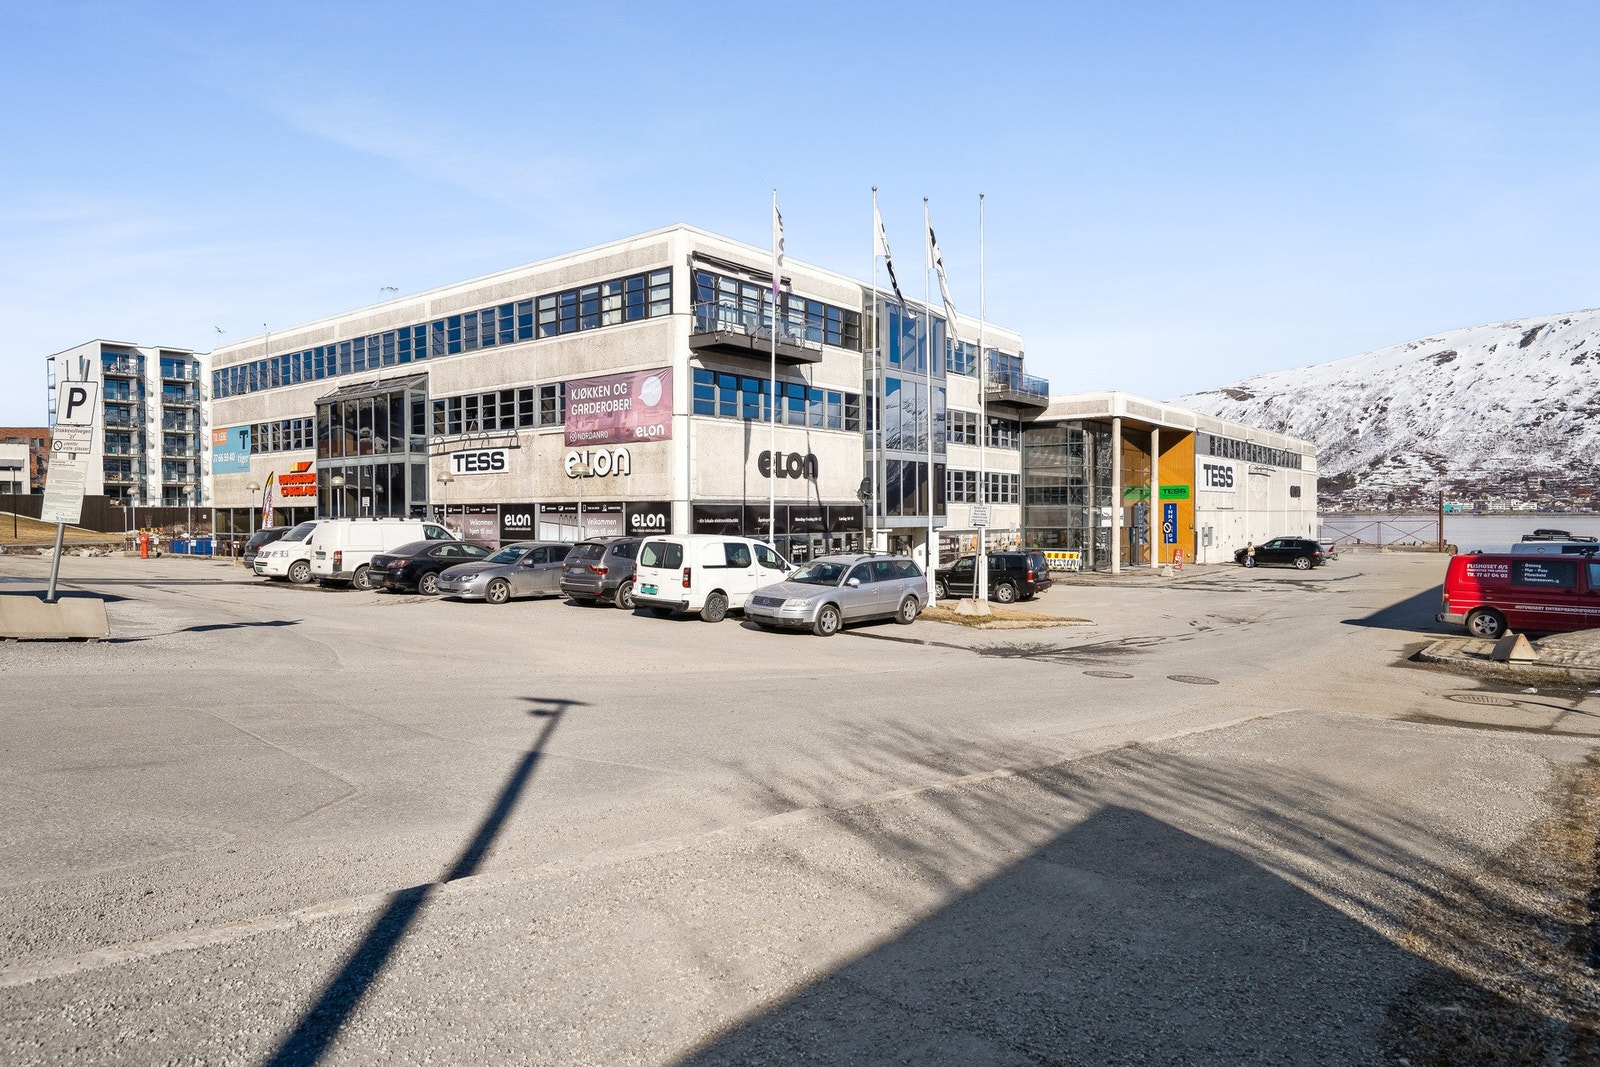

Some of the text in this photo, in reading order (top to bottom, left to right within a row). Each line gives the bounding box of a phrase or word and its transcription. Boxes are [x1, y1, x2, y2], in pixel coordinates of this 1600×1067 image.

[571, 384, 611, 400] KJØKKEN
[613, 382, 628, 395] OG
[66, 387, 87, 419] P
[571, 398, 632, 416] GARDEROBER!
[453, 451, 505, 472] TESS
[1203, 463, 1234, 488] TESS
